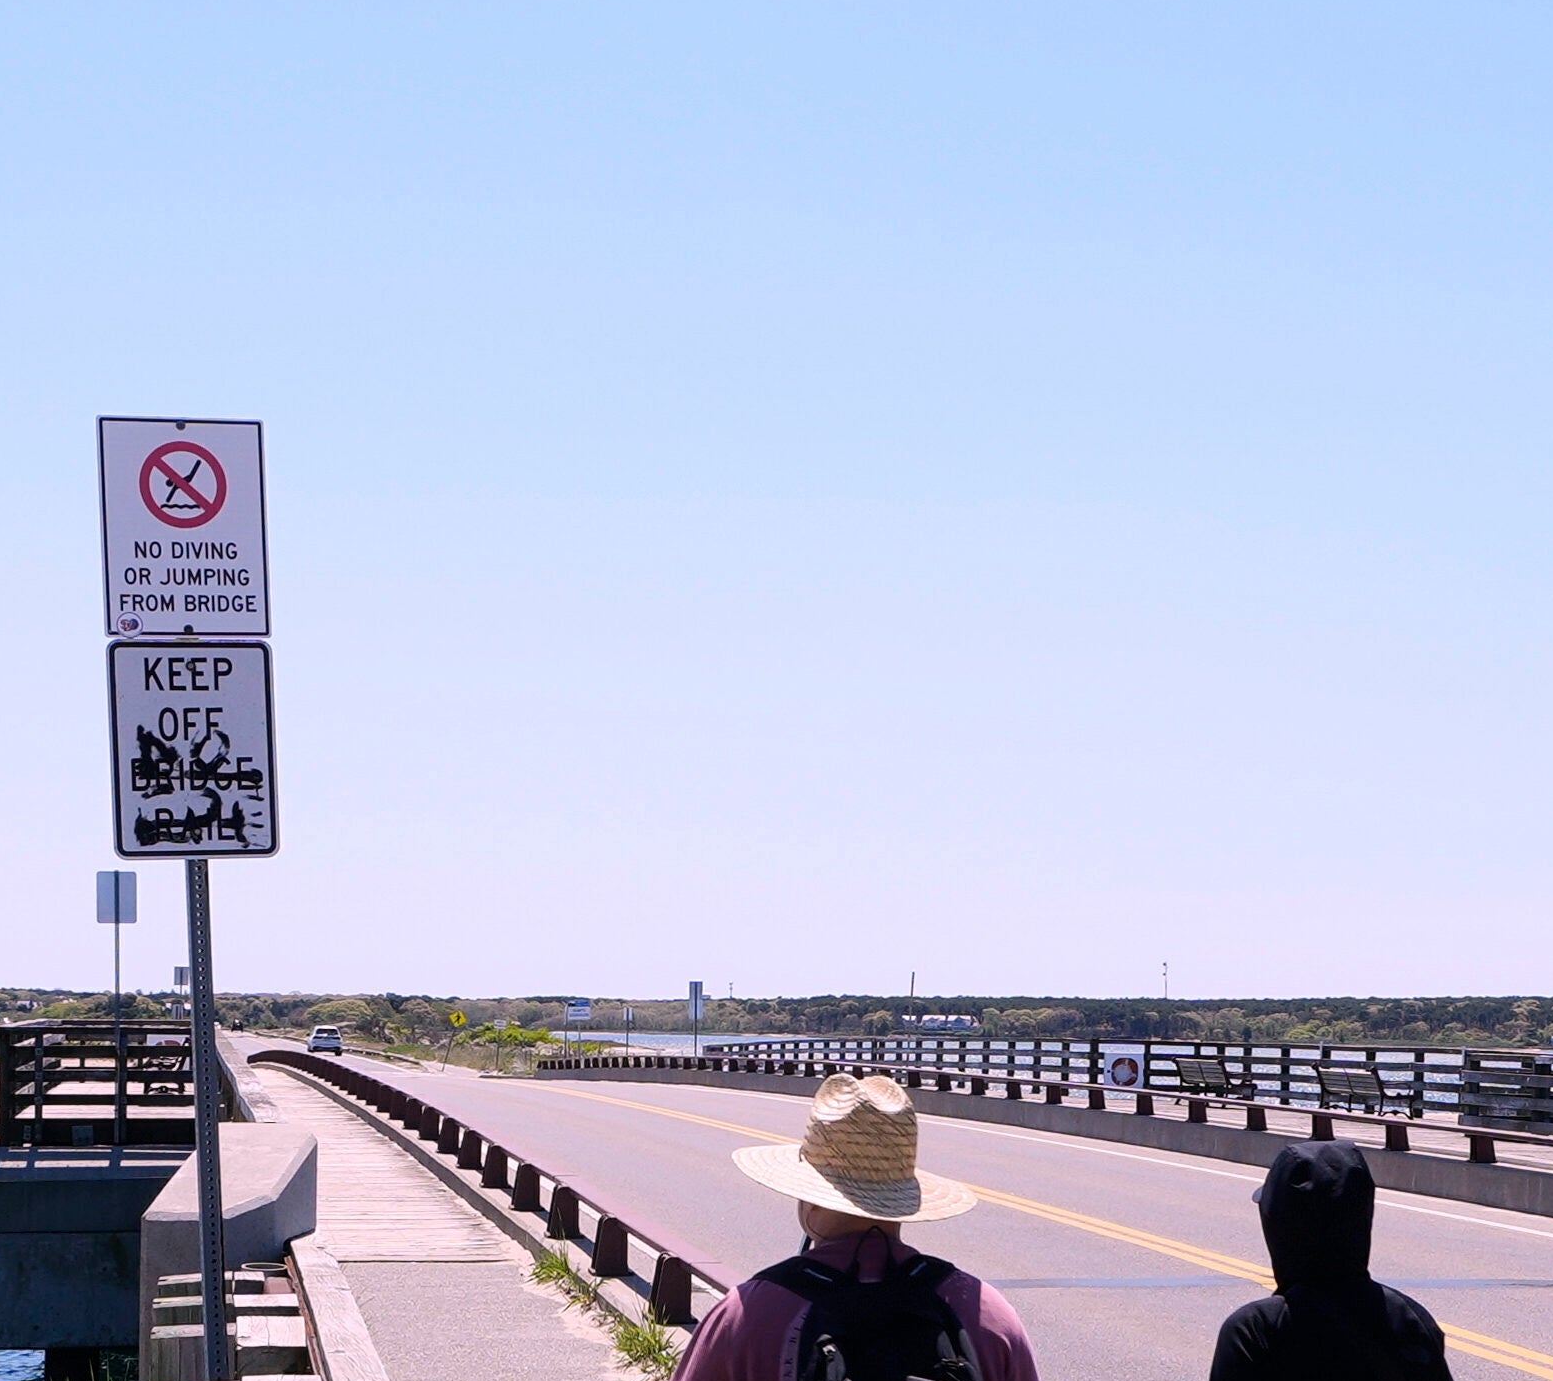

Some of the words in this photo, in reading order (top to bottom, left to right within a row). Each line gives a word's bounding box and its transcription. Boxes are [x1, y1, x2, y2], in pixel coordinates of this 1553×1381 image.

[134, 541, 162, 560] NO
[171, 541, 238, 560] DIVING
[124, 568, 151, 586] OR
[159, 568, 250, 586] JUMPING
[119, 594, 175, 613] FROM
[185, 594, 257, 613] BRIDGE
[144, 657, 233, 691] KEEP
[158, 707, 223, 741] OFF
